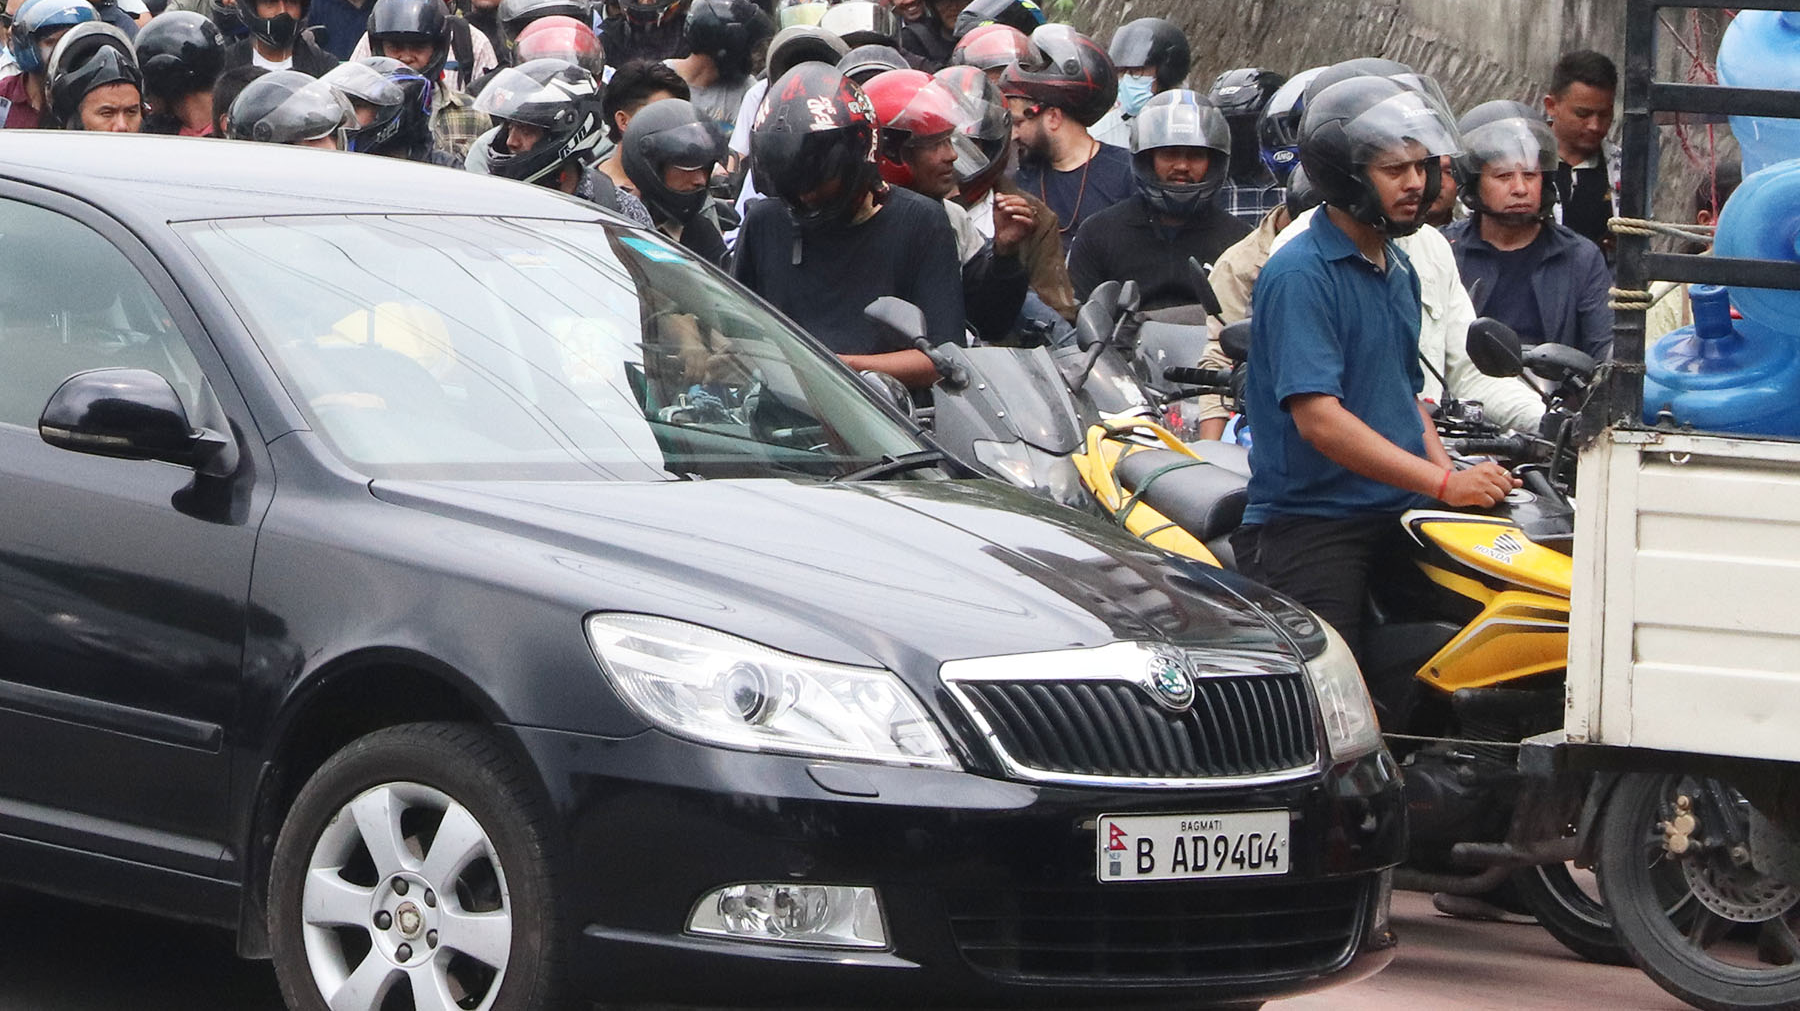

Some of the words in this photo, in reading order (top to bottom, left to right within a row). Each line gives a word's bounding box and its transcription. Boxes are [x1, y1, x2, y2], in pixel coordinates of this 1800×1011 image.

[1473, 543, 1512, 565] HONDA
[1181, 820, 1222, 832] BAGMATI
[1136, 837, 1155, 874] B
[1171, 832, 1279, 873] AD9404
